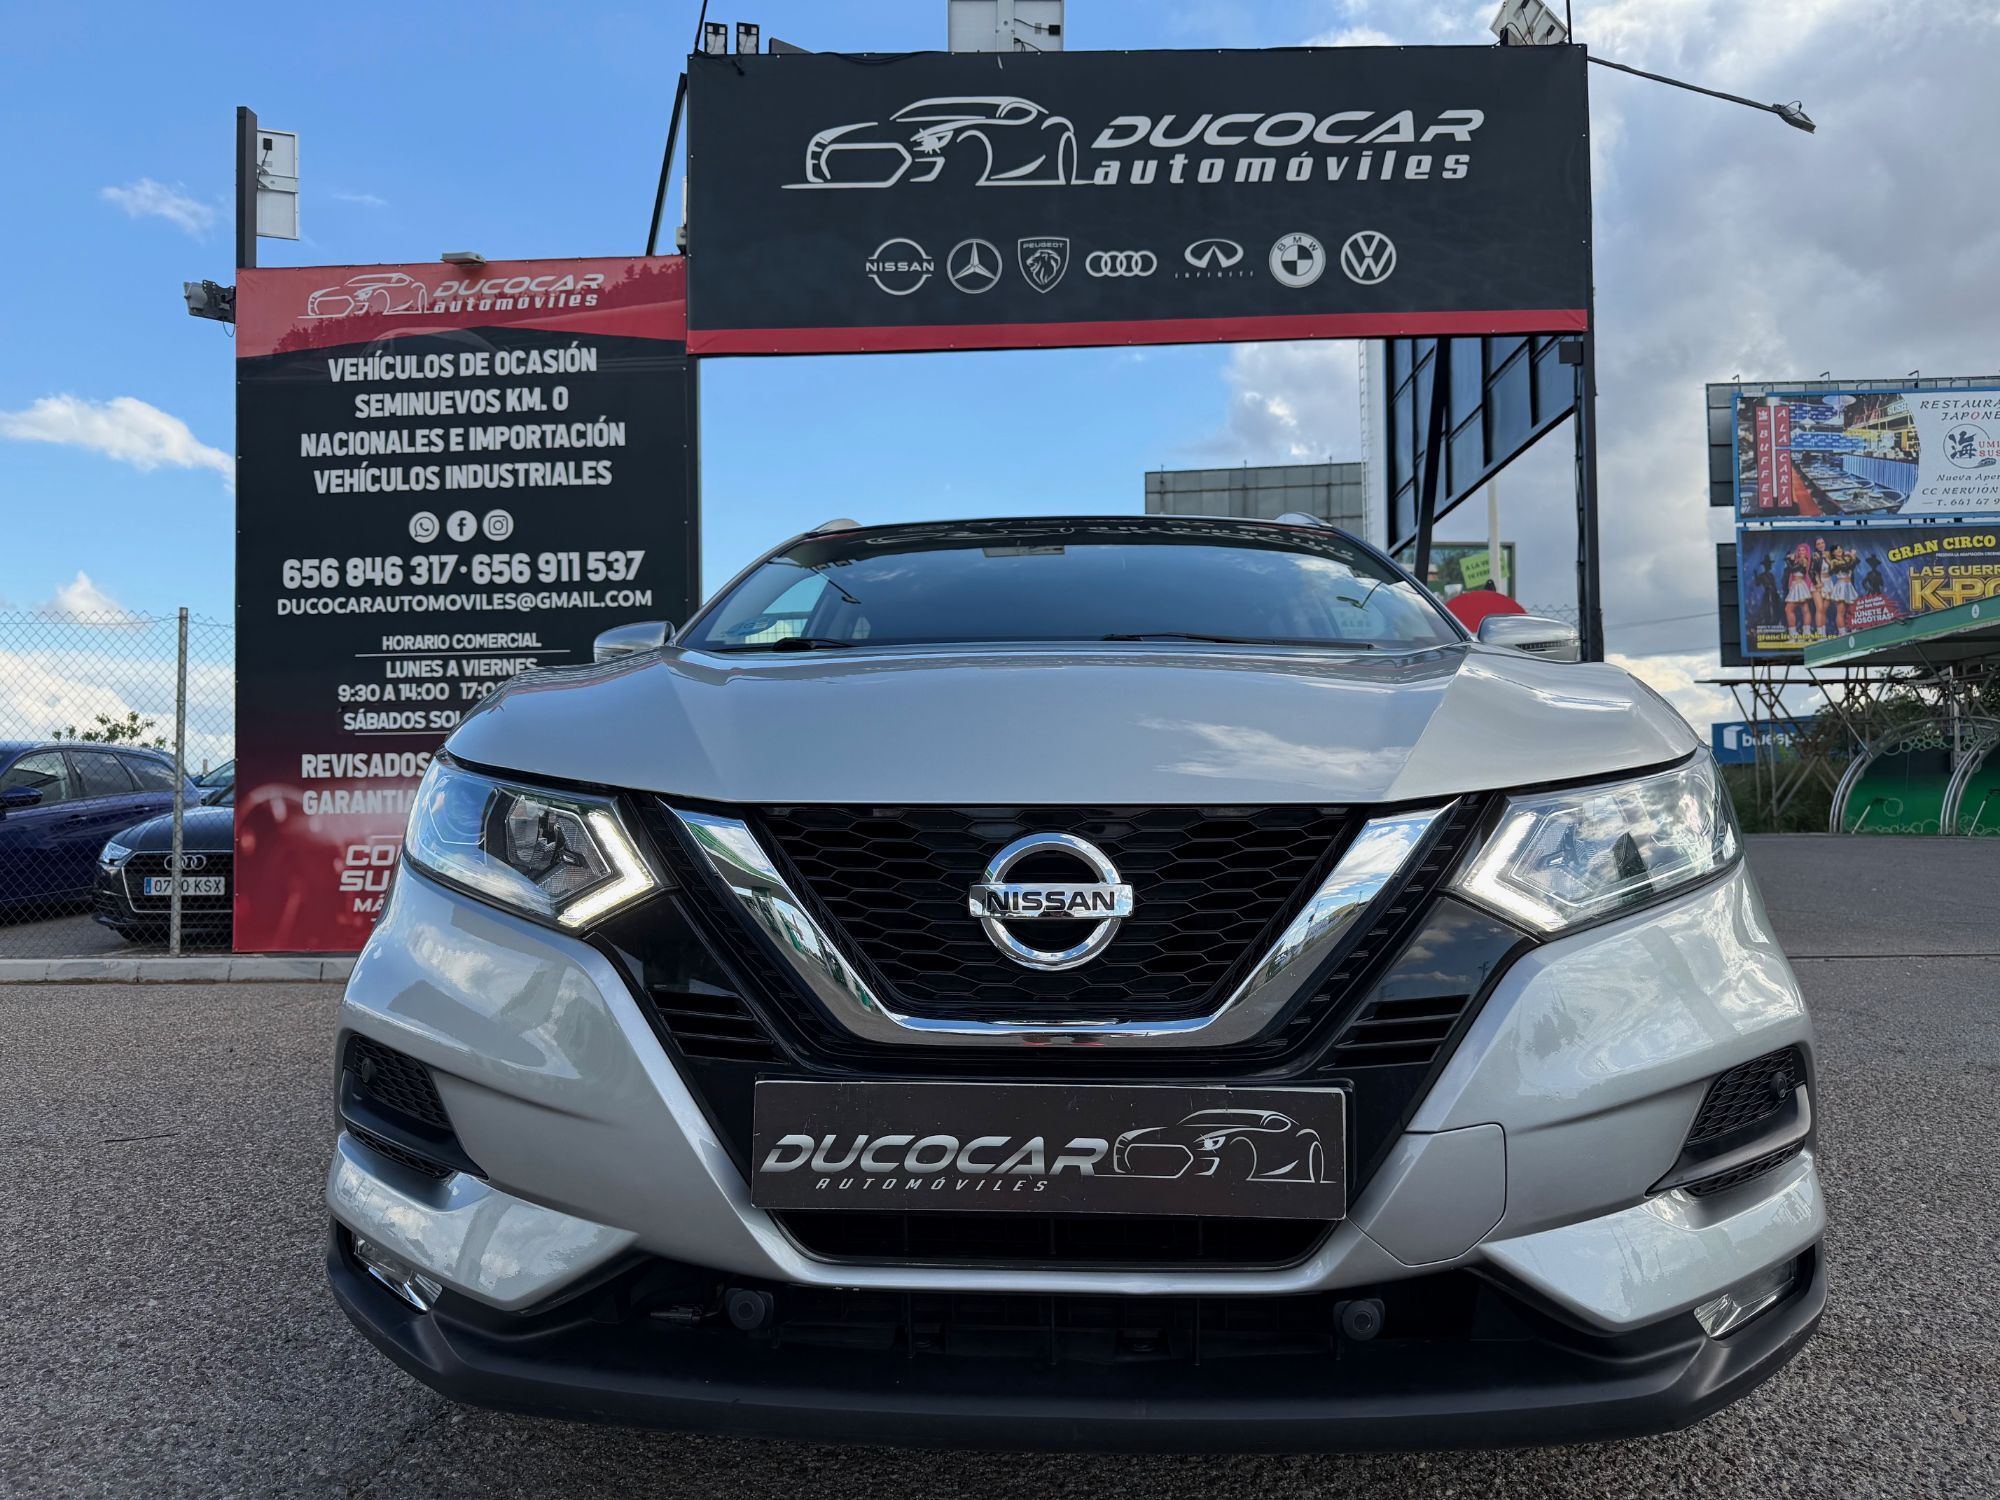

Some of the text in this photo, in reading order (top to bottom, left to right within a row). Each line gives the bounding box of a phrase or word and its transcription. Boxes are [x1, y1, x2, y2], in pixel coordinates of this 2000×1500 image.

[1091, 109, 1485, 148] DUCOCAR
[1095, 149, 1471, 186] automóviles
[1022, 241, 1065, 249] PEUGEOT
[865, 261, 935, 272] NISSAN
[433, 272, 605, 297] DUCOCAR
[433, 290, 599, 314] automóviles
[328, 340, 597, 382] VEHÍCULOS DE OCASIÓN
[354, 389, 501, 419] SEMINUEVOS
[506, 387, 548, 412] KM.
[1778, 409, 1787, 418] A
[300, 415, 626, 457] NACIONALES E IMPORTACIÓN
[314, 460, 613, 494] VEHÍCULOS INDUSTRIALES
[1759, 429, 1770, 506] BUFFET
[1779, 453, 1790, 506] CARTA
[1936, 473, 1972, 481] Nueva
[1921, 487, 1938, 496] CC
[1887, 534, 1997, 562] GRAN CIRCO
[282, 557, 340, 590] 656
[345, 555, 404, 588] 846
[537, 551, 581, 584] 911
[587, 550, 646, 582] 537
[1909, 565, 1945, 577] LAS
[277, 589, 652, 616] DUCOCARAUTOMOVILES@GMAIL.COM
[382, 632, 543, 651] HORARIO COMERCIAL
[386, 659, 444, 679] LUNES
[446, 659, 460, 677] A
[337, 684, 381, 702] 9:30
[383, 684, 396, 702] A
[398, 682, 450, 701] 14:00
[343, 708, 427, 731] SÁBADOS
[301, 752, 432, 778] REVISADOS
[154, 879, 222, 893] 070 KSX
[986, 891, 1115, 911] NISSAN
[759, 1134, 1108, 1175] DUCOCAR
[815, 1177, 1049, 1193] AUTOMÓVILES
